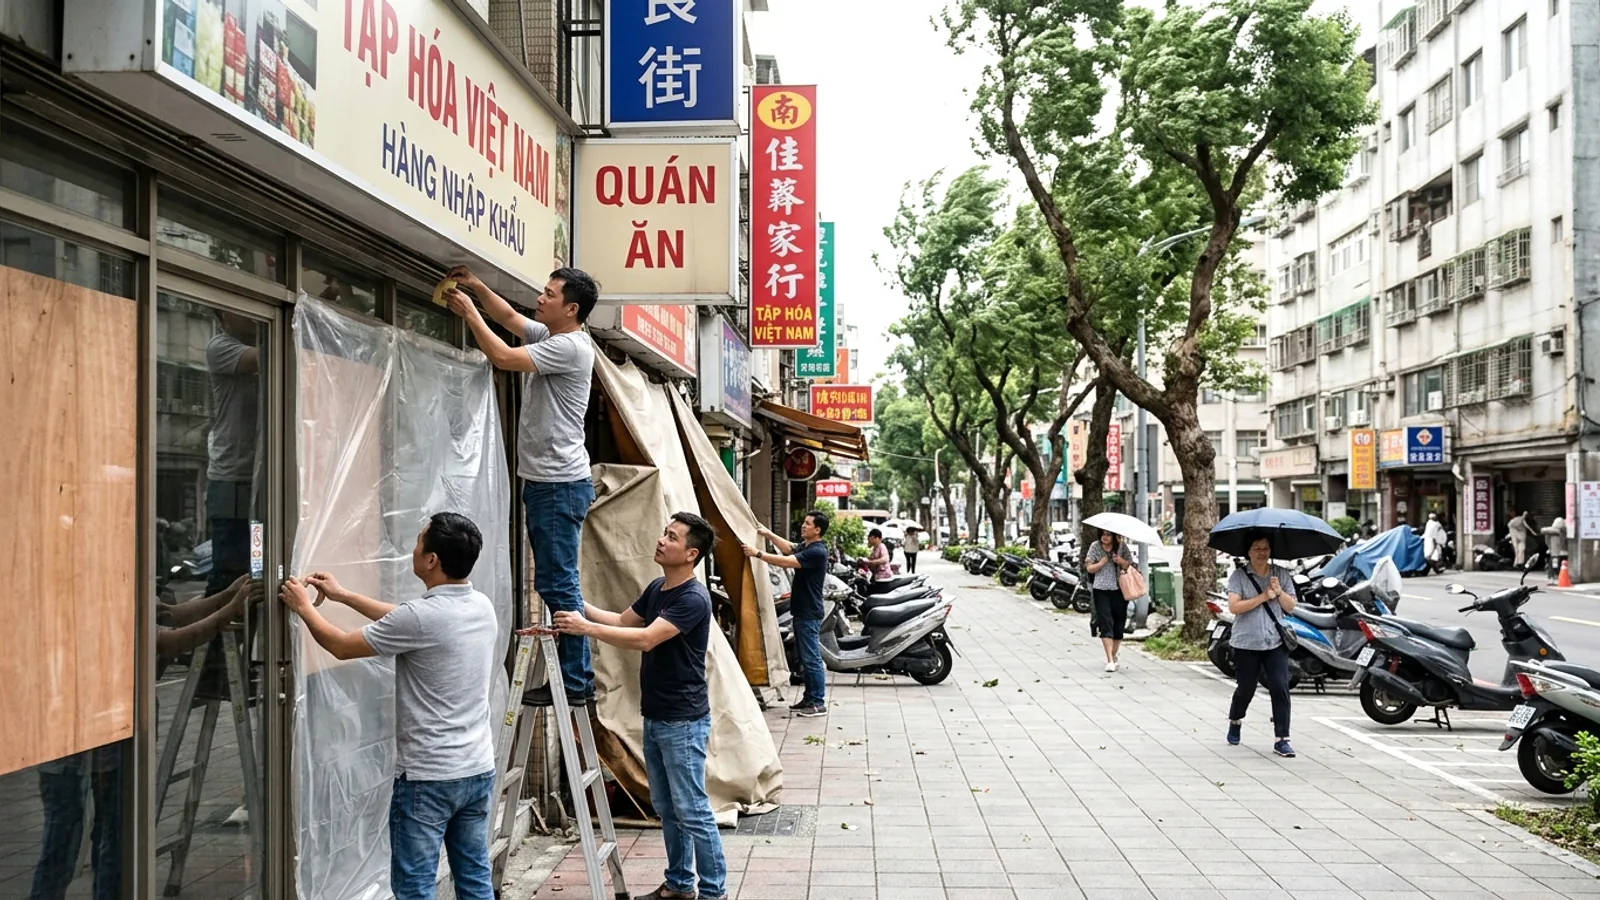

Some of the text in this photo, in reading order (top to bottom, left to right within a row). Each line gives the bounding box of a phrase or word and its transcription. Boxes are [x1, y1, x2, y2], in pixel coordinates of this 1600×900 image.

[408, 23, 458, 136] HÓA
[465, 75, 509, 179] VIỆT
[513, 121, 549, 208] NAM
[770, 94, 798, 125] 南
[382, 121, 526, 257] HÀNG NHẬP KHẨU
[595, 154, 716, 208] QUÁN
[625, 220, 684, 269] ĂN
[754, 322, 814, 344] VIỆT NAM
[785, 303, 813, 321] HÓA
